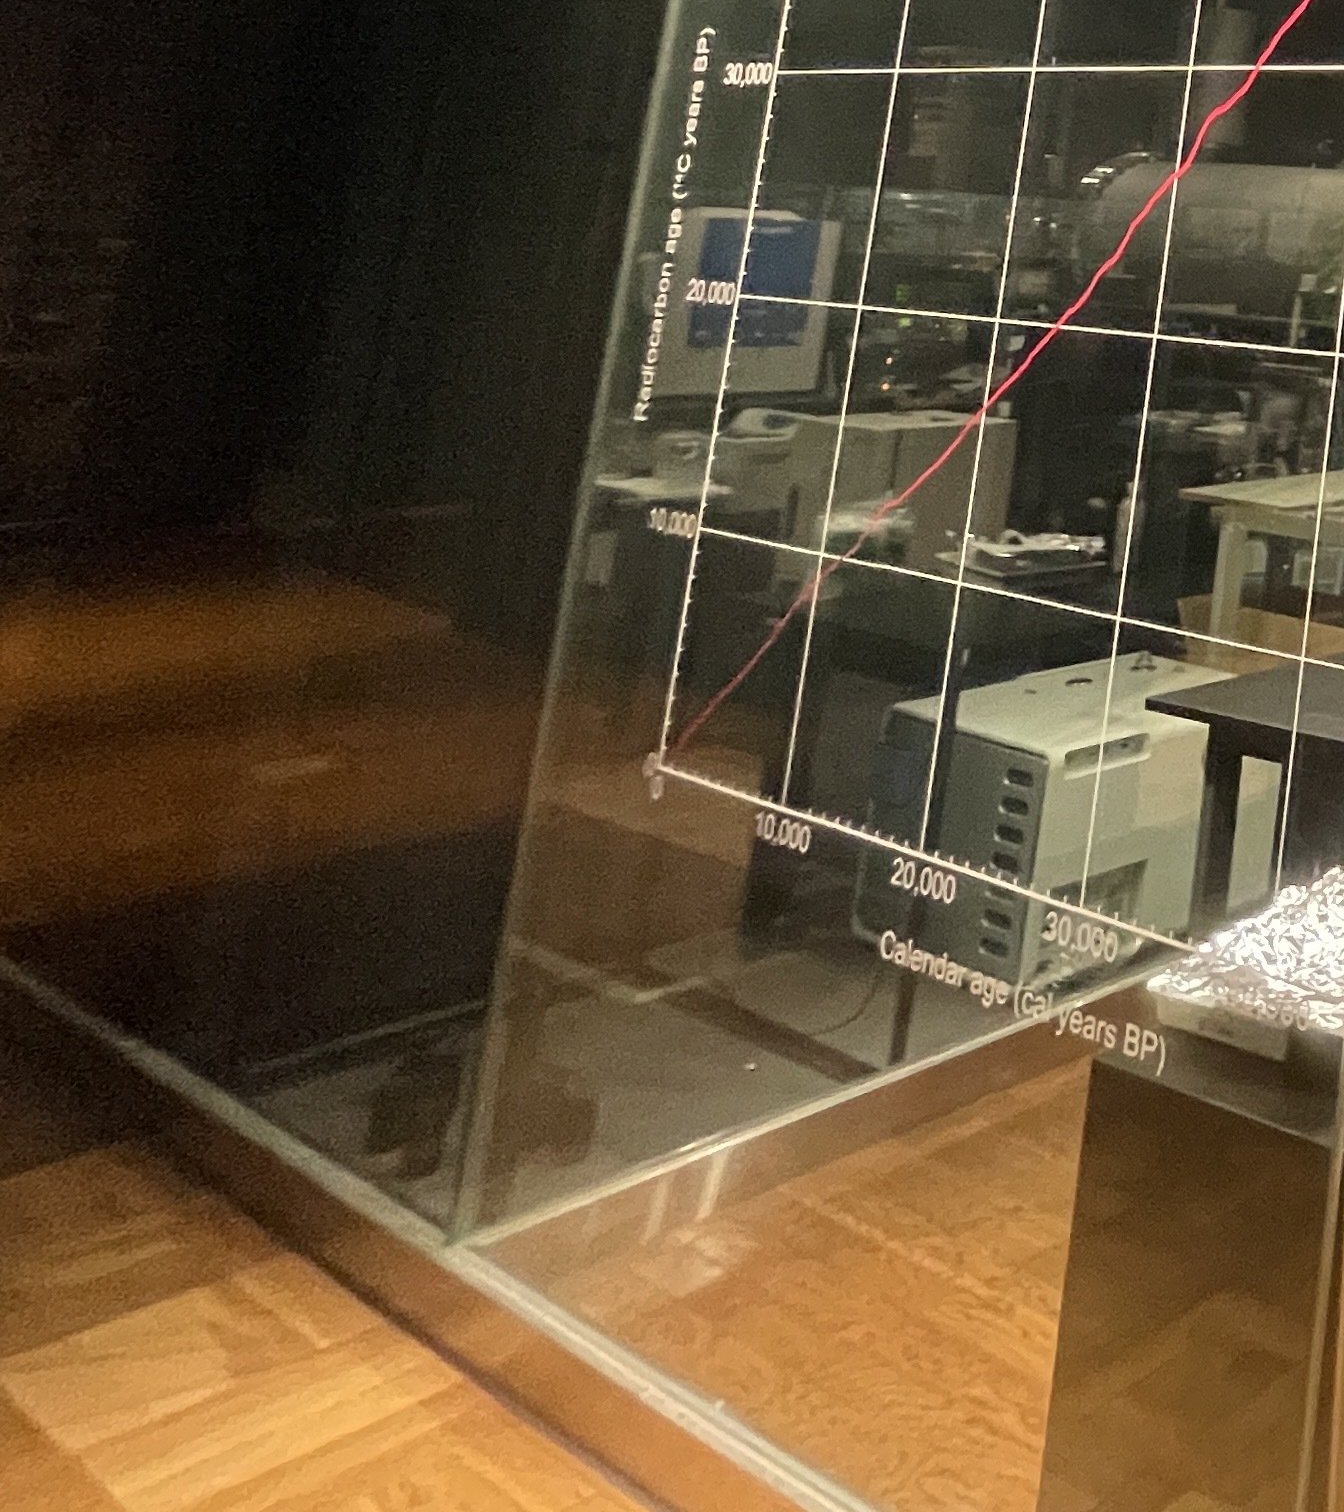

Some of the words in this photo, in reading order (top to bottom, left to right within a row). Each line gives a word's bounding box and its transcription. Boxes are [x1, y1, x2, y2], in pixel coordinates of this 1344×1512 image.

[723, 63, 773, 88] 30,000
[686, 277, 736, 306] 20,000
[633, 262, 674, 422] Radiocarbon
[755, 810, 811, 854] 10,000
[891, 857, 957, 906] 20,000
[1042, 911, 1119, 963] 30,000
[880, 930, 968, 985] Calendar
[969, 971, 1008, 1007] age
[1013, 980, 1055, 1019] (cal
[1055, 1001, 1118, 1051] years
[1123, 1022, 1168, 1076] BP)
